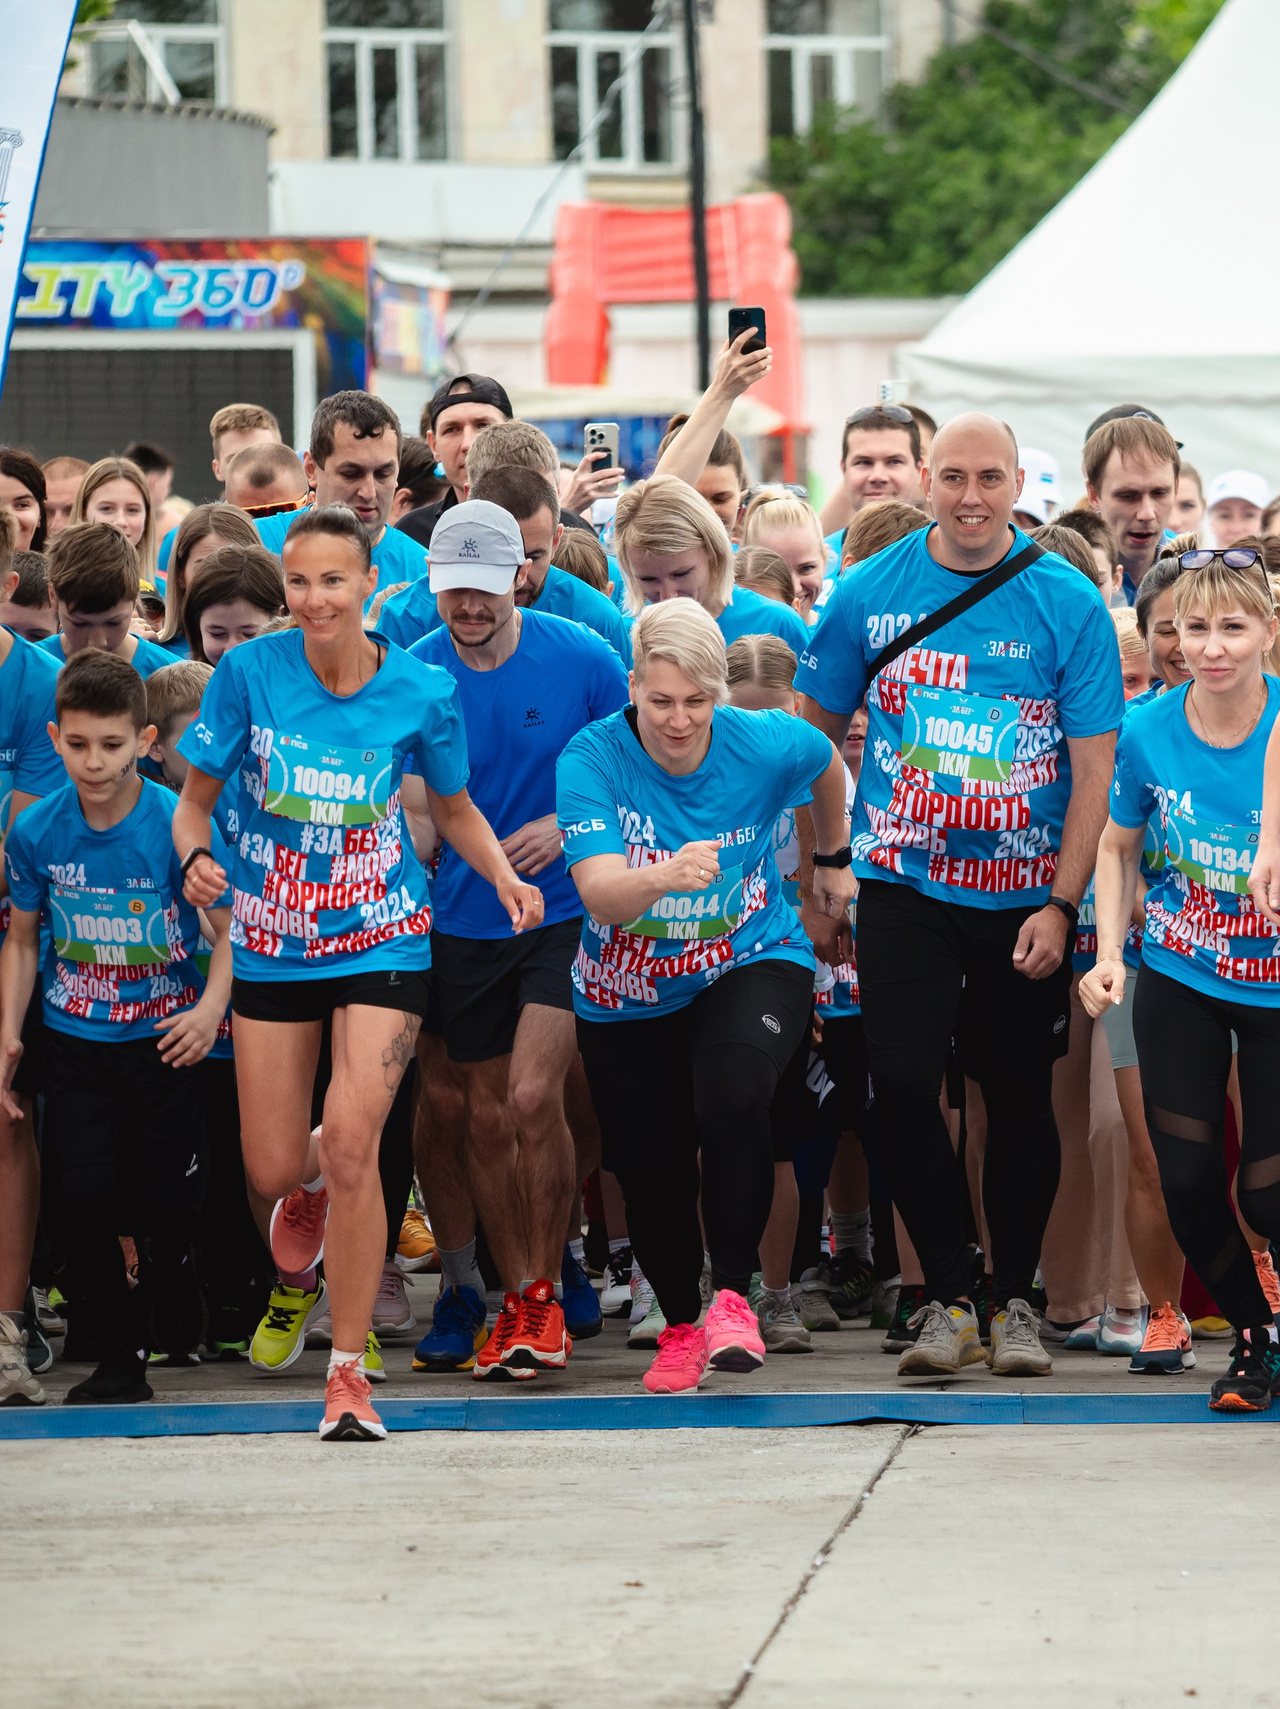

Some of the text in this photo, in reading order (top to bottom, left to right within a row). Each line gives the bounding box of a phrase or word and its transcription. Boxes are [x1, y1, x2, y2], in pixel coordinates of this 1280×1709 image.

[925, 716, 993, 754] 10045
[293, 765, 366, 801] 10094
[994, 824, 1052, 858] 2024
[1189, 838, 1252, 873] 10134
[360, 885, 416, 929] 2024
[651, 894, 720, 920] 10044
[72, 914, 143, 943] 10003
